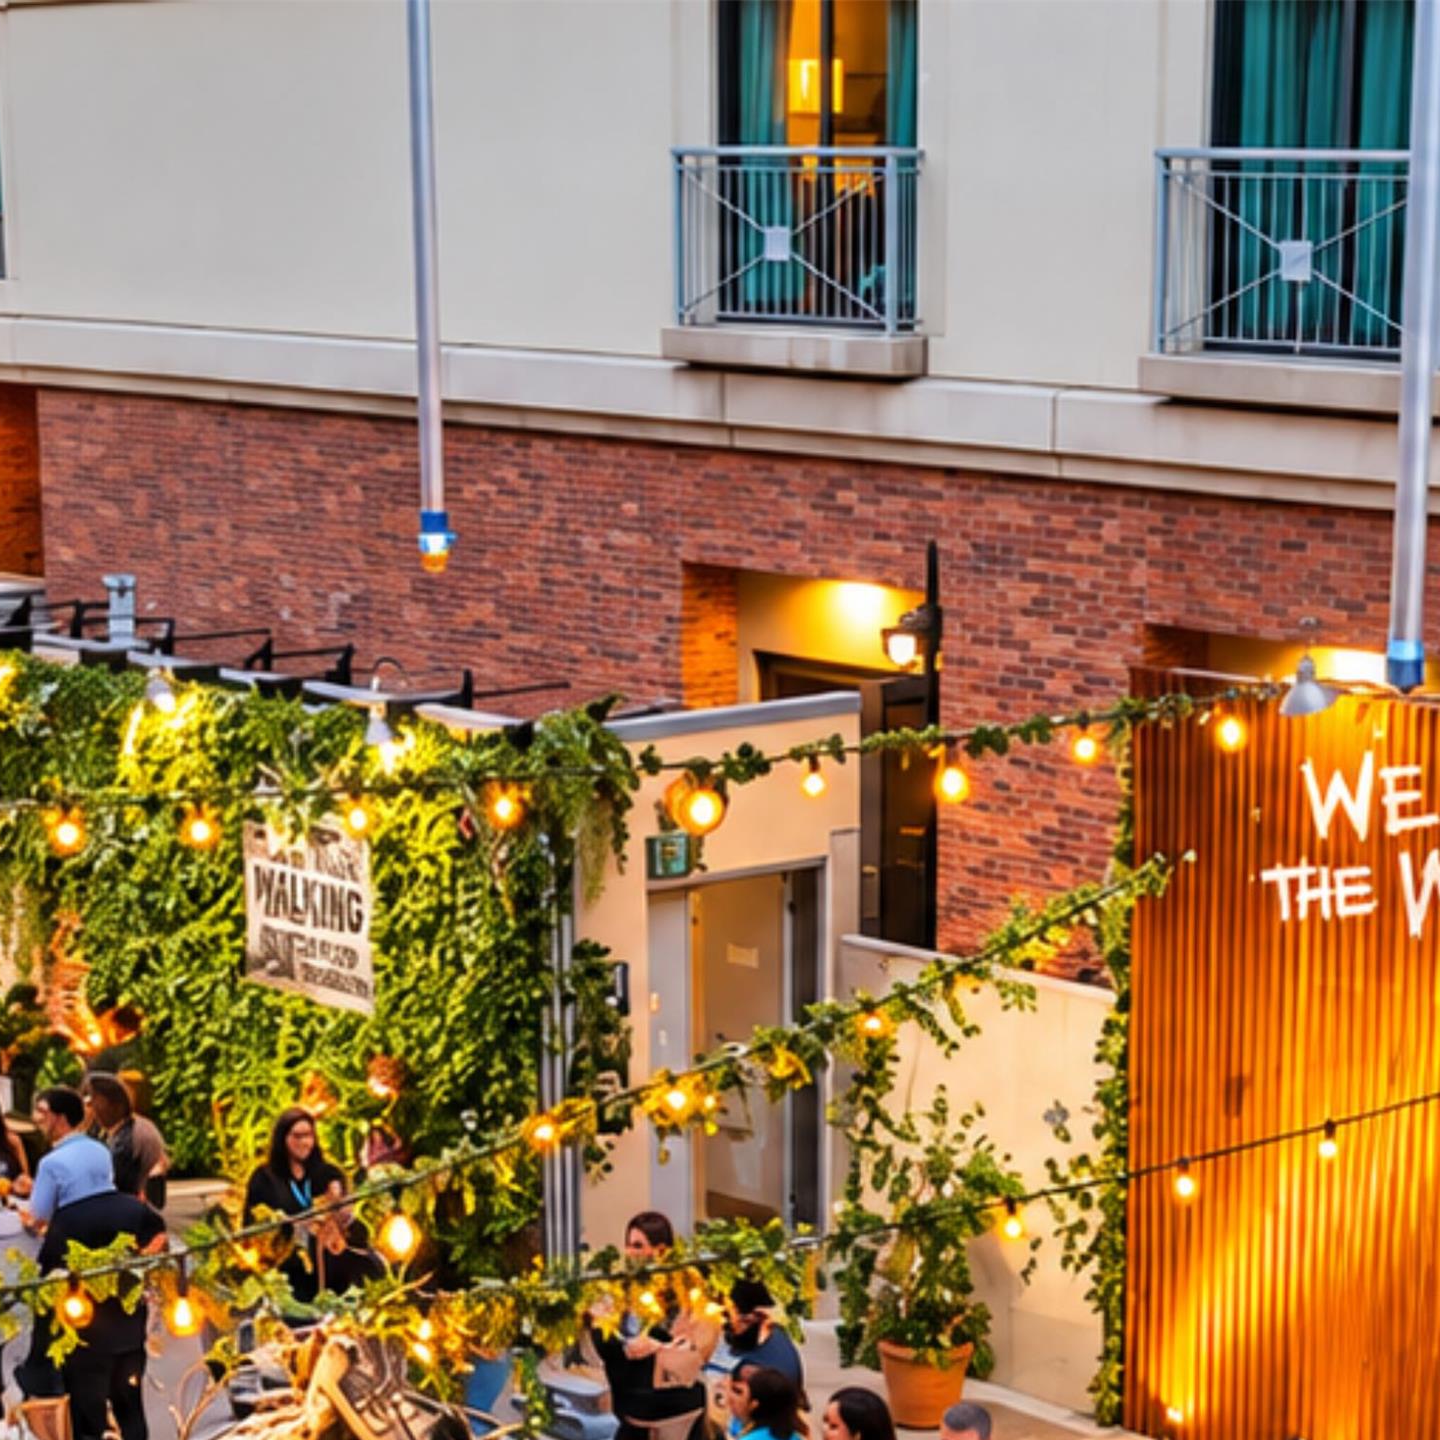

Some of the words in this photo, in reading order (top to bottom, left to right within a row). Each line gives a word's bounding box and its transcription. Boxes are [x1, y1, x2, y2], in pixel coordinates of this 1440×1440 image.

[1300, 750, 1440, 842] WE
[254, 864, 364, 935] WALKING
[1260, 857, 1378, 921] THE
